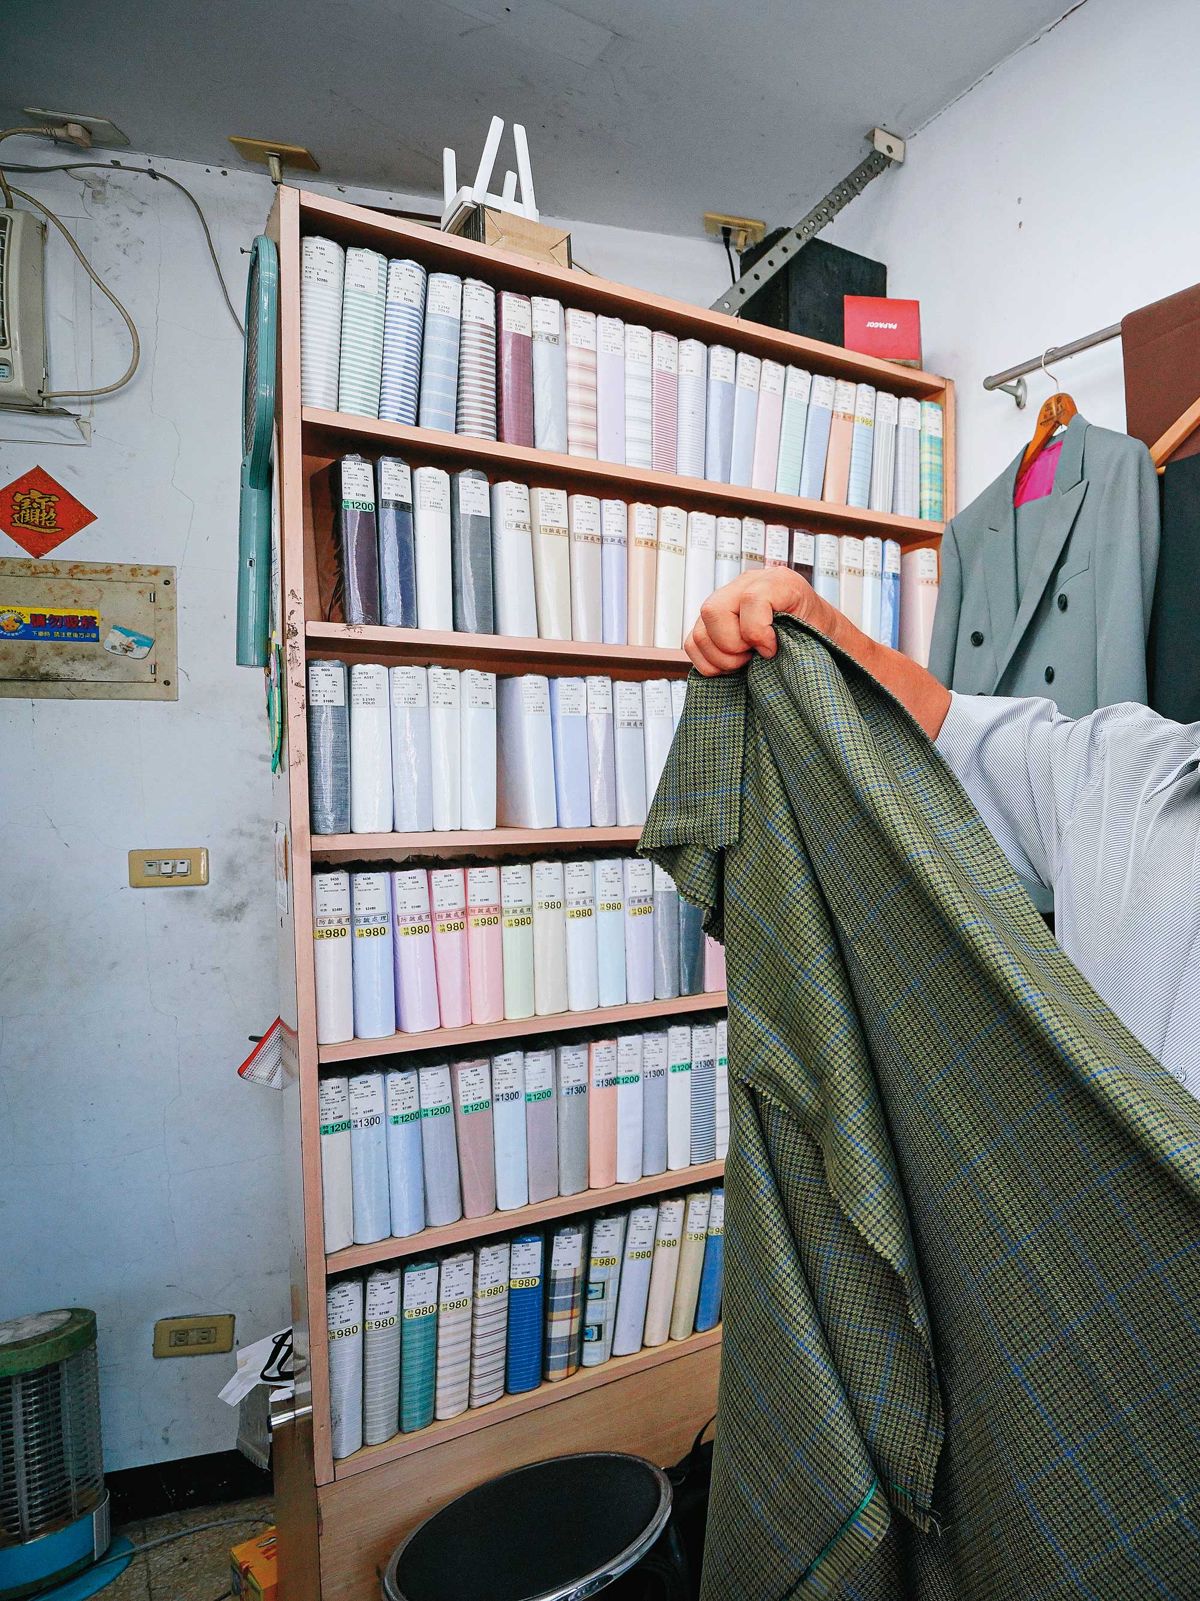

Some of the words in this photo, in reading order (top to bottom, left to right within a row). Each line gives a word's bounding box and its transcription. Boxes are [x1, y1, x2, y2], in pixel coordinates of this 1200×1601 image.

[352, 501, 373, 510] 1200
[543, 901, 562, 910] 980
[605, 902, 622, 911] 980
[637, 906, 652, 915] 980
[575, 908, 593, 918] 980
[446, 921, 465, 931] 980
[480, 916, 499, 926] 980
[514, 916, 531, 926] 980
[325, 928, 347, 938] 980
[365, 927, 386, 937] 980
[410, 924, 430, 935] 980
[677, 1062, 692, 1072] 1200
[699, 1059, 714, 1068] 1300
[649, 1069, 664, 1078] 1300
[601, 1077, 617, 1087] 1300
[621, 1075, 639, 1084] 1200
[533, 1090, 551, 1100] 1200
[570, 1085, 587, 1095] 1300
[500, 1091, 519, 1101] 1300
[430, 1106, 451, 1116] 1200
[470, 1102, 489, 1111] 1200
[359, 1116, 381, 1127] 1300
[400, 1111, 420, 1123] 1200
[331, 1121, 351, 1133] 1200
[661, 1239, 677, 1247] 980
[635, 1251, 651, 1259] 980
[599, 1257, 616, 1266] 980
[517, 1278, 536, 1287] 980
[486, 1285, 504, 1297] 980
[449, 1299, 468, 1311] 980
[414, 1305, 435, 1317] 980
[374, 1317, 395, 1329] 980
[336, 1325, 359, 1339] 980
